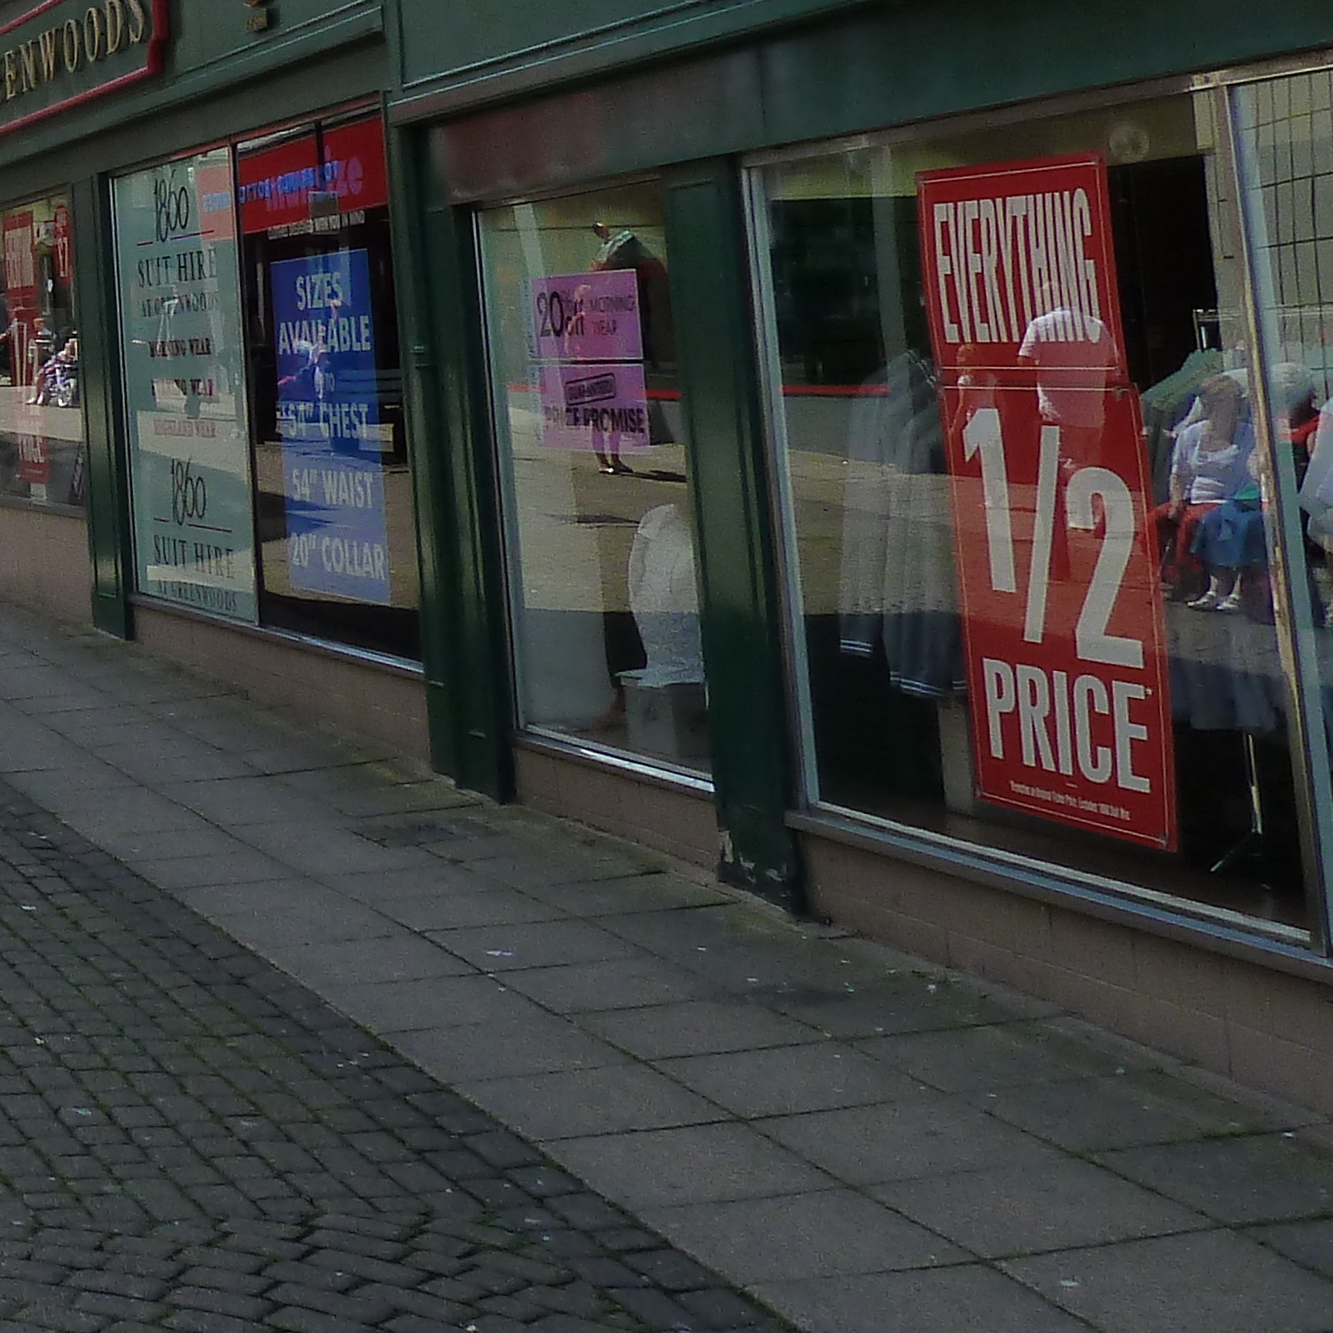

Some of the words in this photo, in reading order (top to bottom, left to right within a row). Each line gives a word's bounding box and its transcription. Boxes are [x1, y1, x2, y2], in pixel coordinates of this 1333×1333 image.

[154, 170, 189, 243] 1860
[138, 256, 171, 288] SUIT
[177, 246, 217, 282] HIRE
[934, 188, 1100, 343] EVERYTHING
[296, 271, 343, 311] SIZES
[278, 315, 371, 356] AVAILABLE
[320, 403, 369, 439] CHEST
[583, 407, 645, 433] PROMISE
[170, 450, 206, 526] 1860
[292, 468, 317, 503] 54"
[322, 469, 374, 509] WAIST
[154, 534, 188, 567] SUIT
[195, 542, 234, 579] HIRE
[291, 532, 317, 567] 20"
[322, 535, 386, 581] COLLAR
[962, 408, 1144, 669] 1/2
